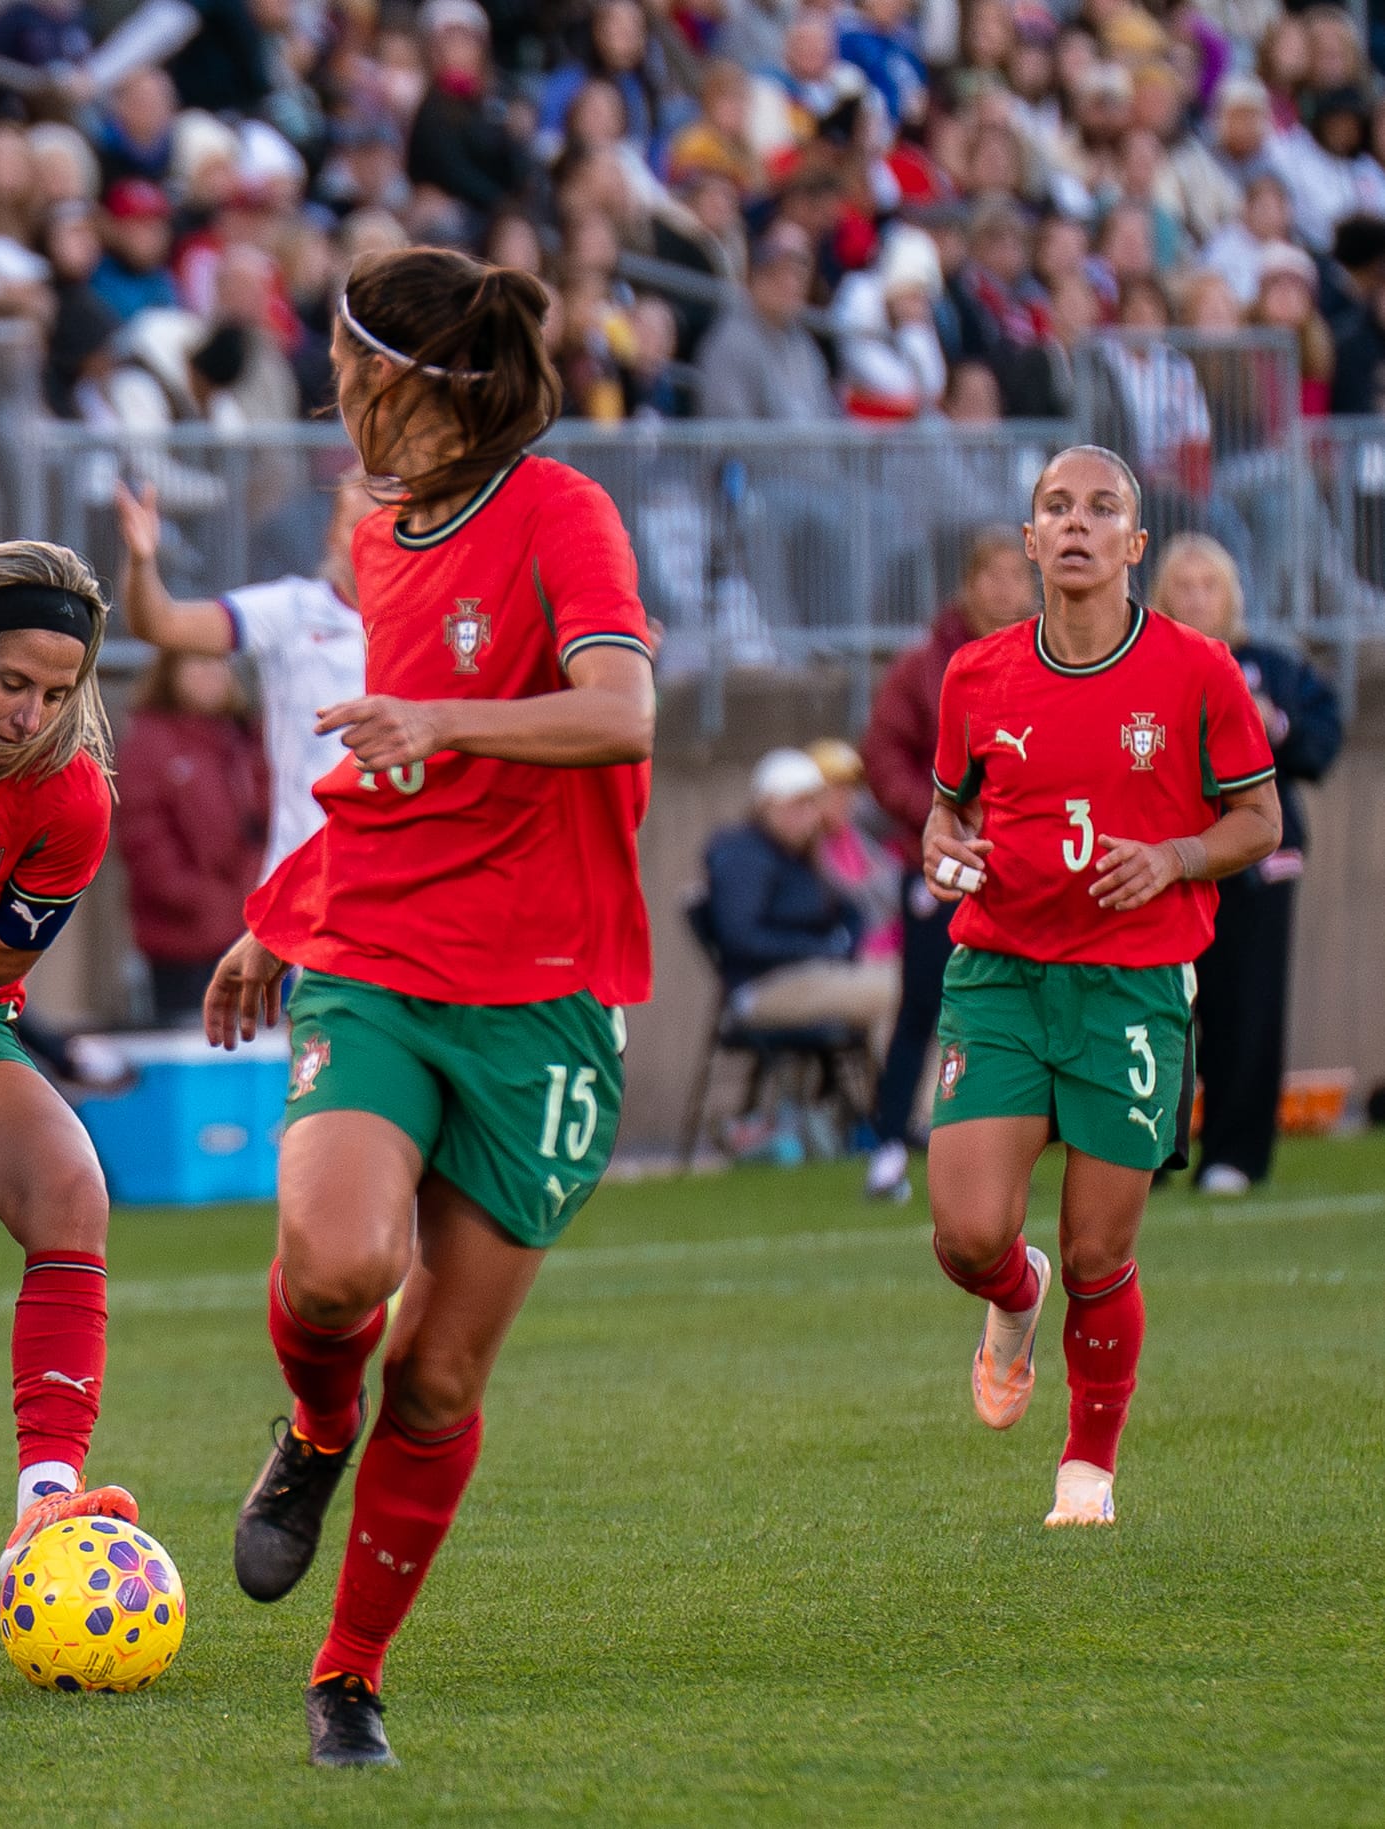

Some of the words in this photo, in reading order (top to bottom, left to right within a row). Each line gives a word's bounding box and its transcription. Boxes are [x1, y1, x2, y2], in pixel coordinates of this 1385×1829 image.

[1062, 799, 1094, 872] 3
[1125, 1024, 1156, 1098] 3
[538, 1063, 598, 1161] 15
